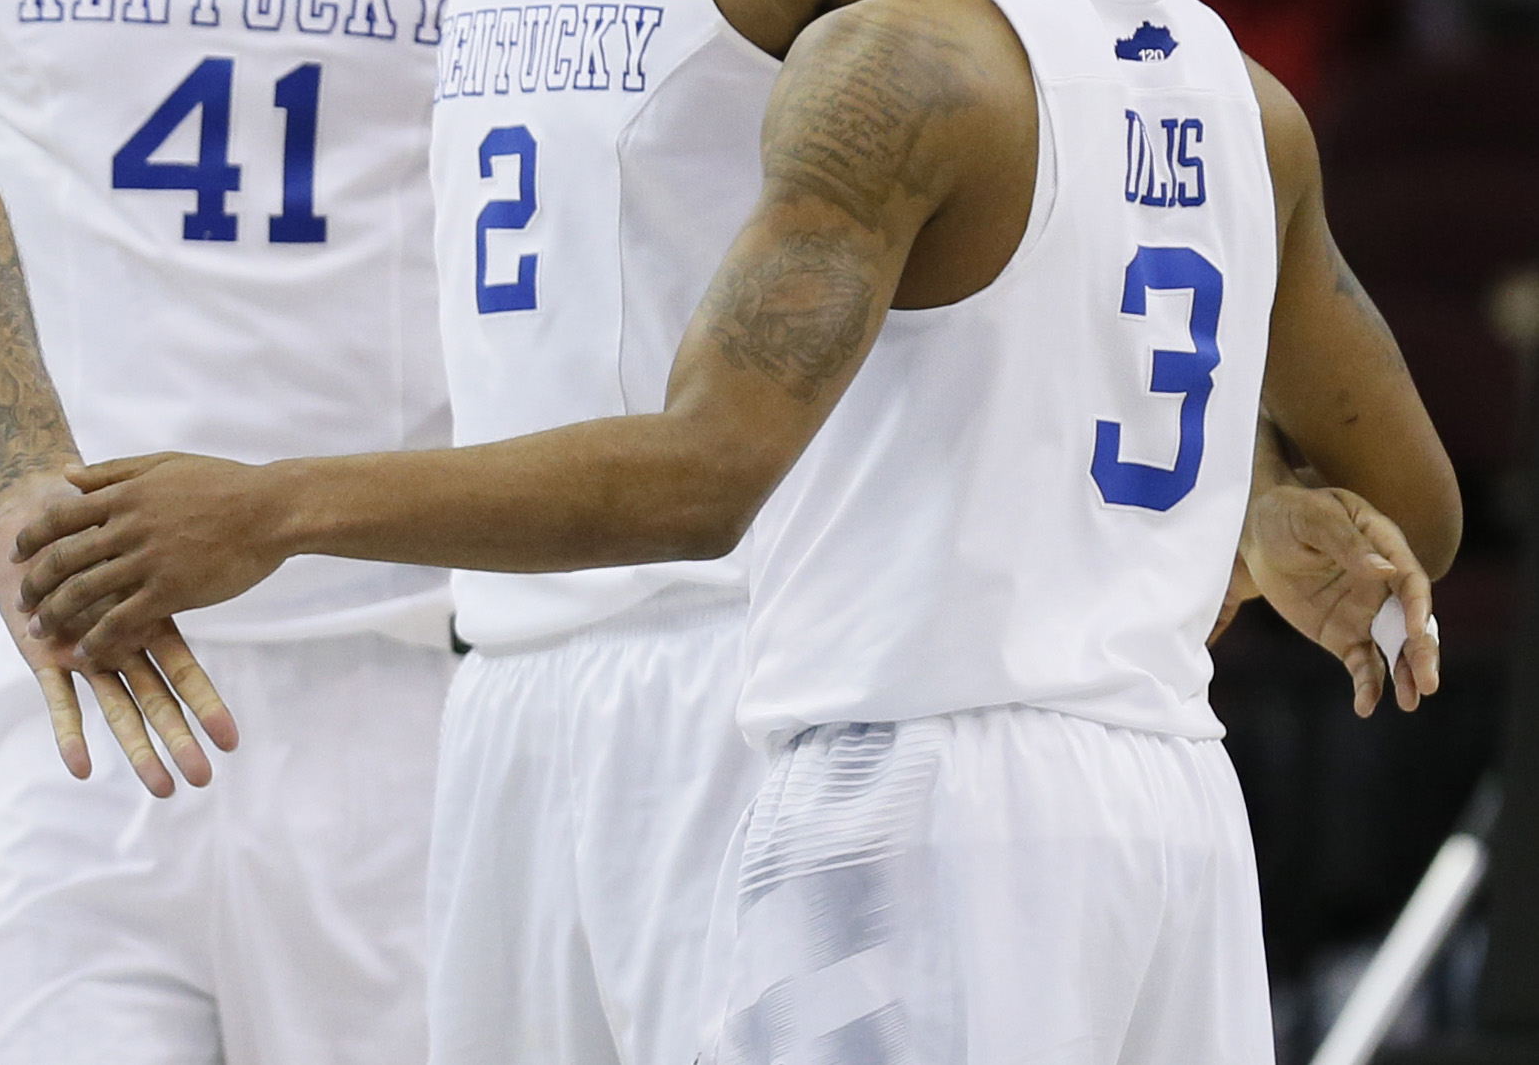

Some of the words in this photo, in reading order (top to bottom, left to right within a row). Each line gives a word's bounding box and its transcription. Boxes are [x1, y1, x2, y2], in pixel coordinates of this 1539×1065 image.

[1138, 48, 1165, 62] 120
[112, 56, 327, 243] 41
[475, 124, 538, 314] 2
[1090, 245, 1224, 512] 3
